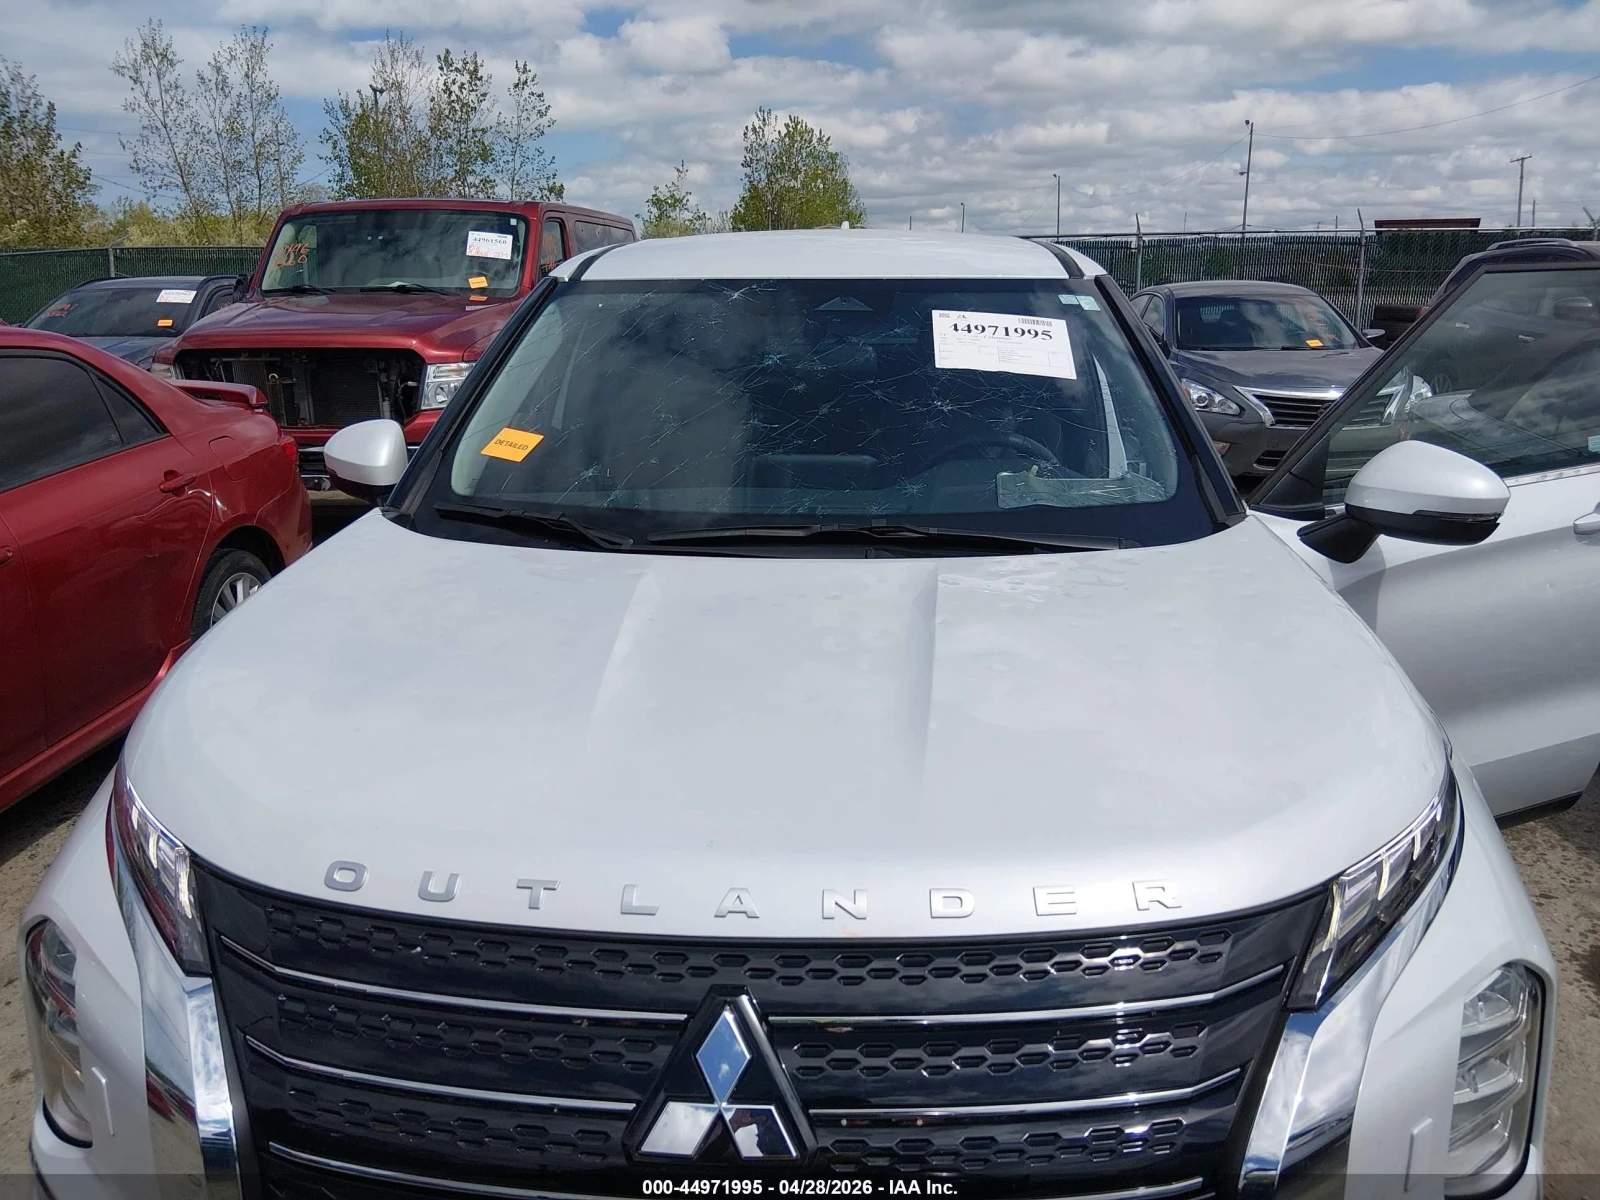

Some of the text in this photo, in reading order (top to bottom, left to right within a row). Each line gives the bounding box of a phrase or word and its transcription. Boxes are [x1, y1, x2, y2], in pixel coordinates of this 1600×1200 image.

[949, 322, 1053, 341] 44971995
[494, 438, 529, 451] DETAILED
[324, 860, 1183, 919] OUTLANDER
